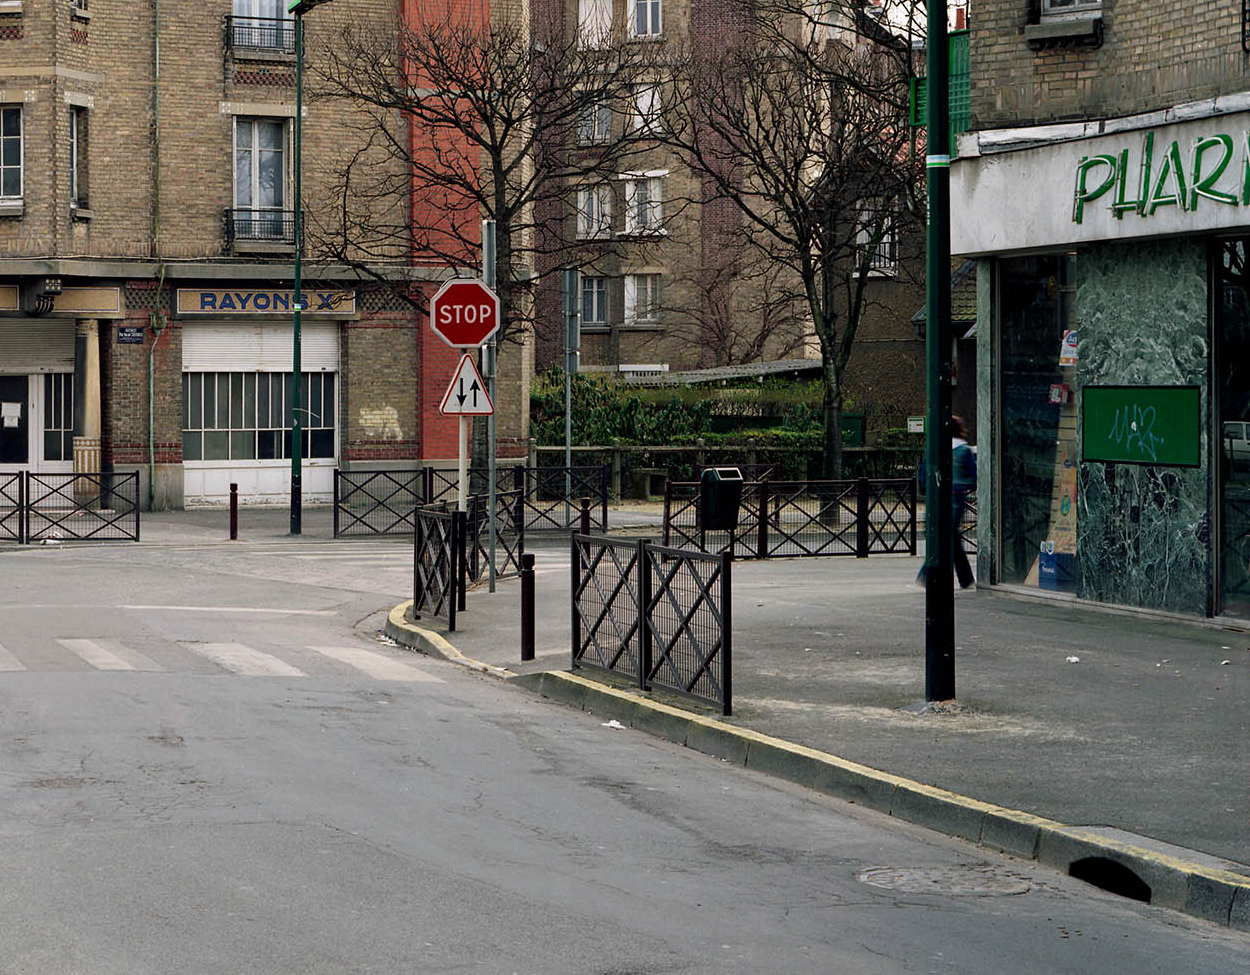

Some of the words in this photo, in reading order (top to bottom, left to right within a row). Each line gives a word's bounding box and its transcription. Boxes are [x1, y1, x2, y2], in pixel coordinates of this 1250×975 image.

[1072, 130, 1250, 224] PHAR
[200, 293, 308, 310] RAYONS
[317, 293, 335, 310] X
[439, 304, 492, 324] STOP
